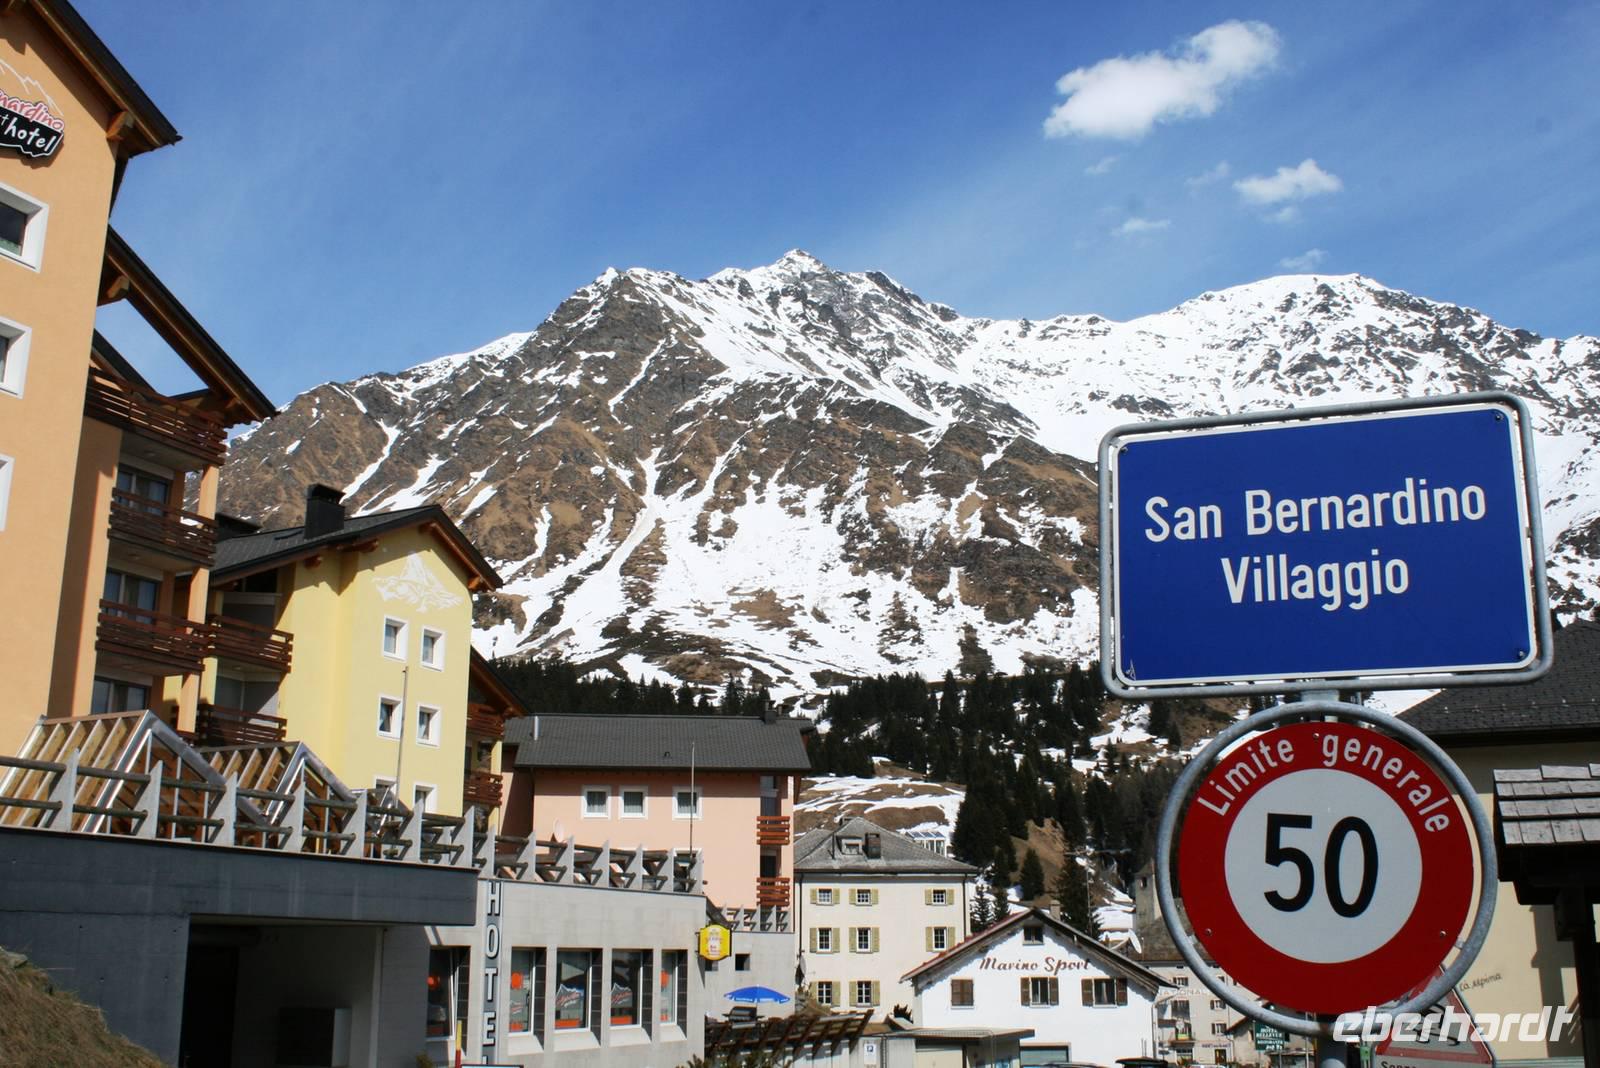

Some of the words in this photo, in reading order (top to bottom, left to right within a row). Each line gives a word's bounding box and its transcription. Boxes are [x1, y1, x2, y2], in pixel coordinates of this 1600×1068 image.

[0, 91, 63, 129] nardino
[4, 117, 56, 152] hotel
[1144, 496, 1222, 542] San
[1245, 477, 1486, 536] Bernardino
[1221, 549, 1409, 611] Villaggio
[1197, 738, 1294, 816] Limite
[1322, 733, 1449, 832] generale
[1264, 812, 1379, 918] 50
[979, 957, 1038, 970] Marino
[1044, 957, 1089, 975] Sport
